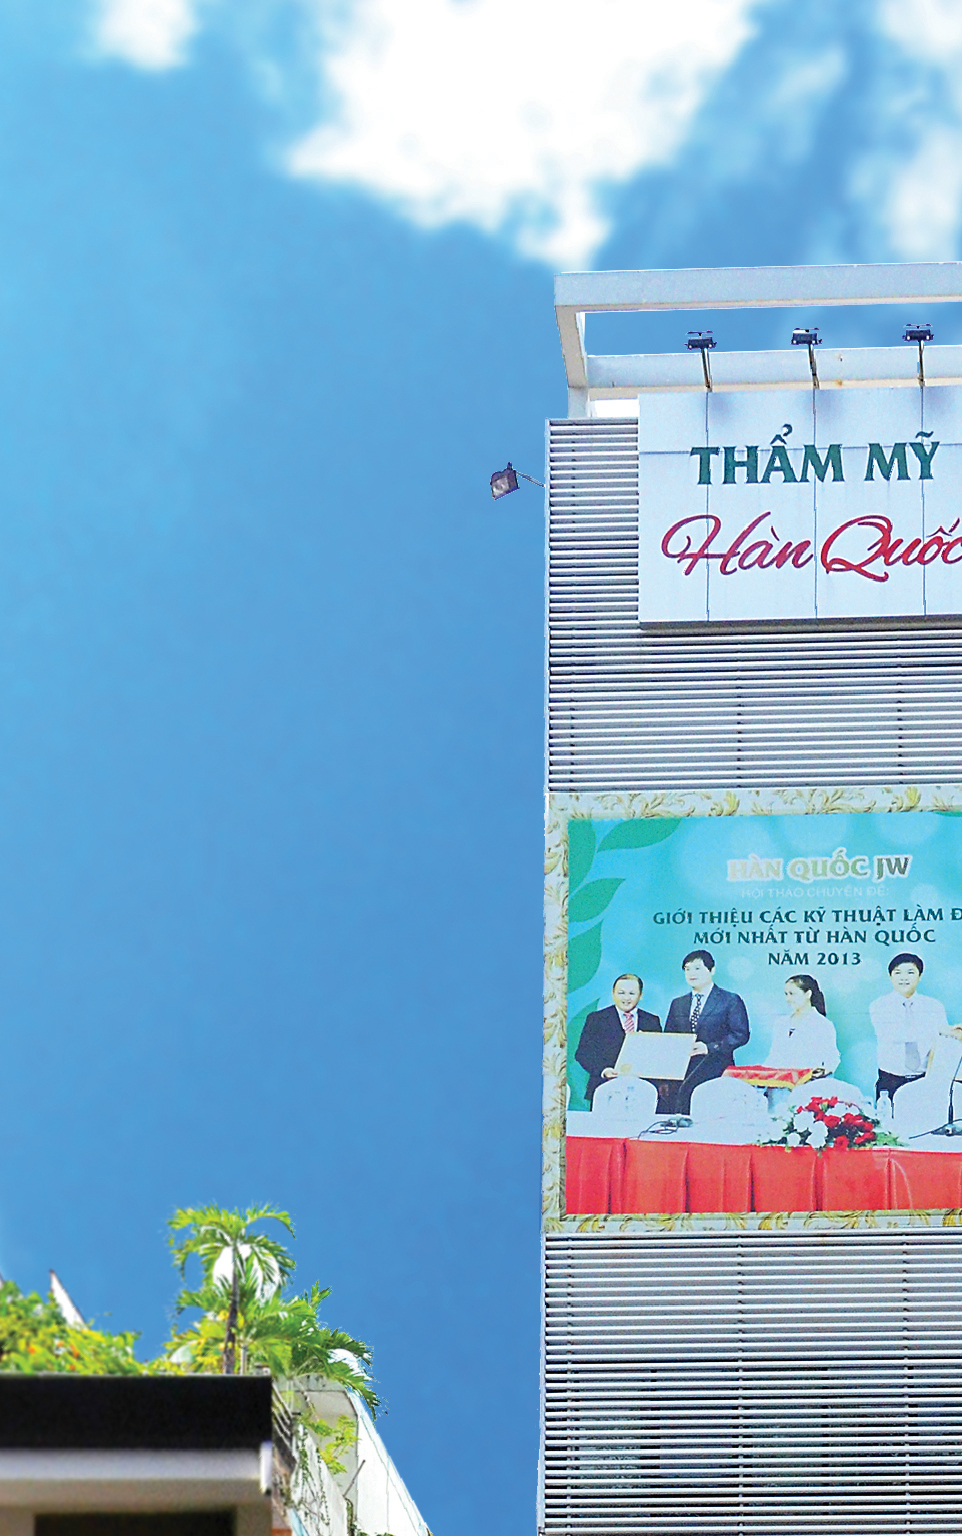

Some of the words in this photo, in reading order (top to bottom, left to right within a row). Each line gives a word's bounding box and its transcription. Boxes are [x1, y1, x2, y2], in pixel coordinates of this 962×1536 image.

[690, 423, 846, 485] THẨM
[863, 430, 940, 482] MỸ
[661, 511, 814, 576] Hàn
[727, 854, 783, 882] HÀN
[788, 847, 869, 883] QUỐC
[873, 854, 912, 883] JW
[653, 908, 693, 925] GIỚI
[699, 908, 753, 928] THIỆU
[759, 907, 797, 924] CÁC
[804, 906, 826, 923] KỸ
[832, 905, 896, 926] THUẬT
[903, 904, 944, 922] LÀM
[693, 927, 731, 944] MỚI
[738, 924, 788, 944] NHẤT
[794, 926, 820, 944] TỪ
[827, 926, 867, 944] HÀN
[874, 922, 936, 947] QUỐC
[768, 950, 809, 966] NĂM
[817, 952, 861, 966] 2013
